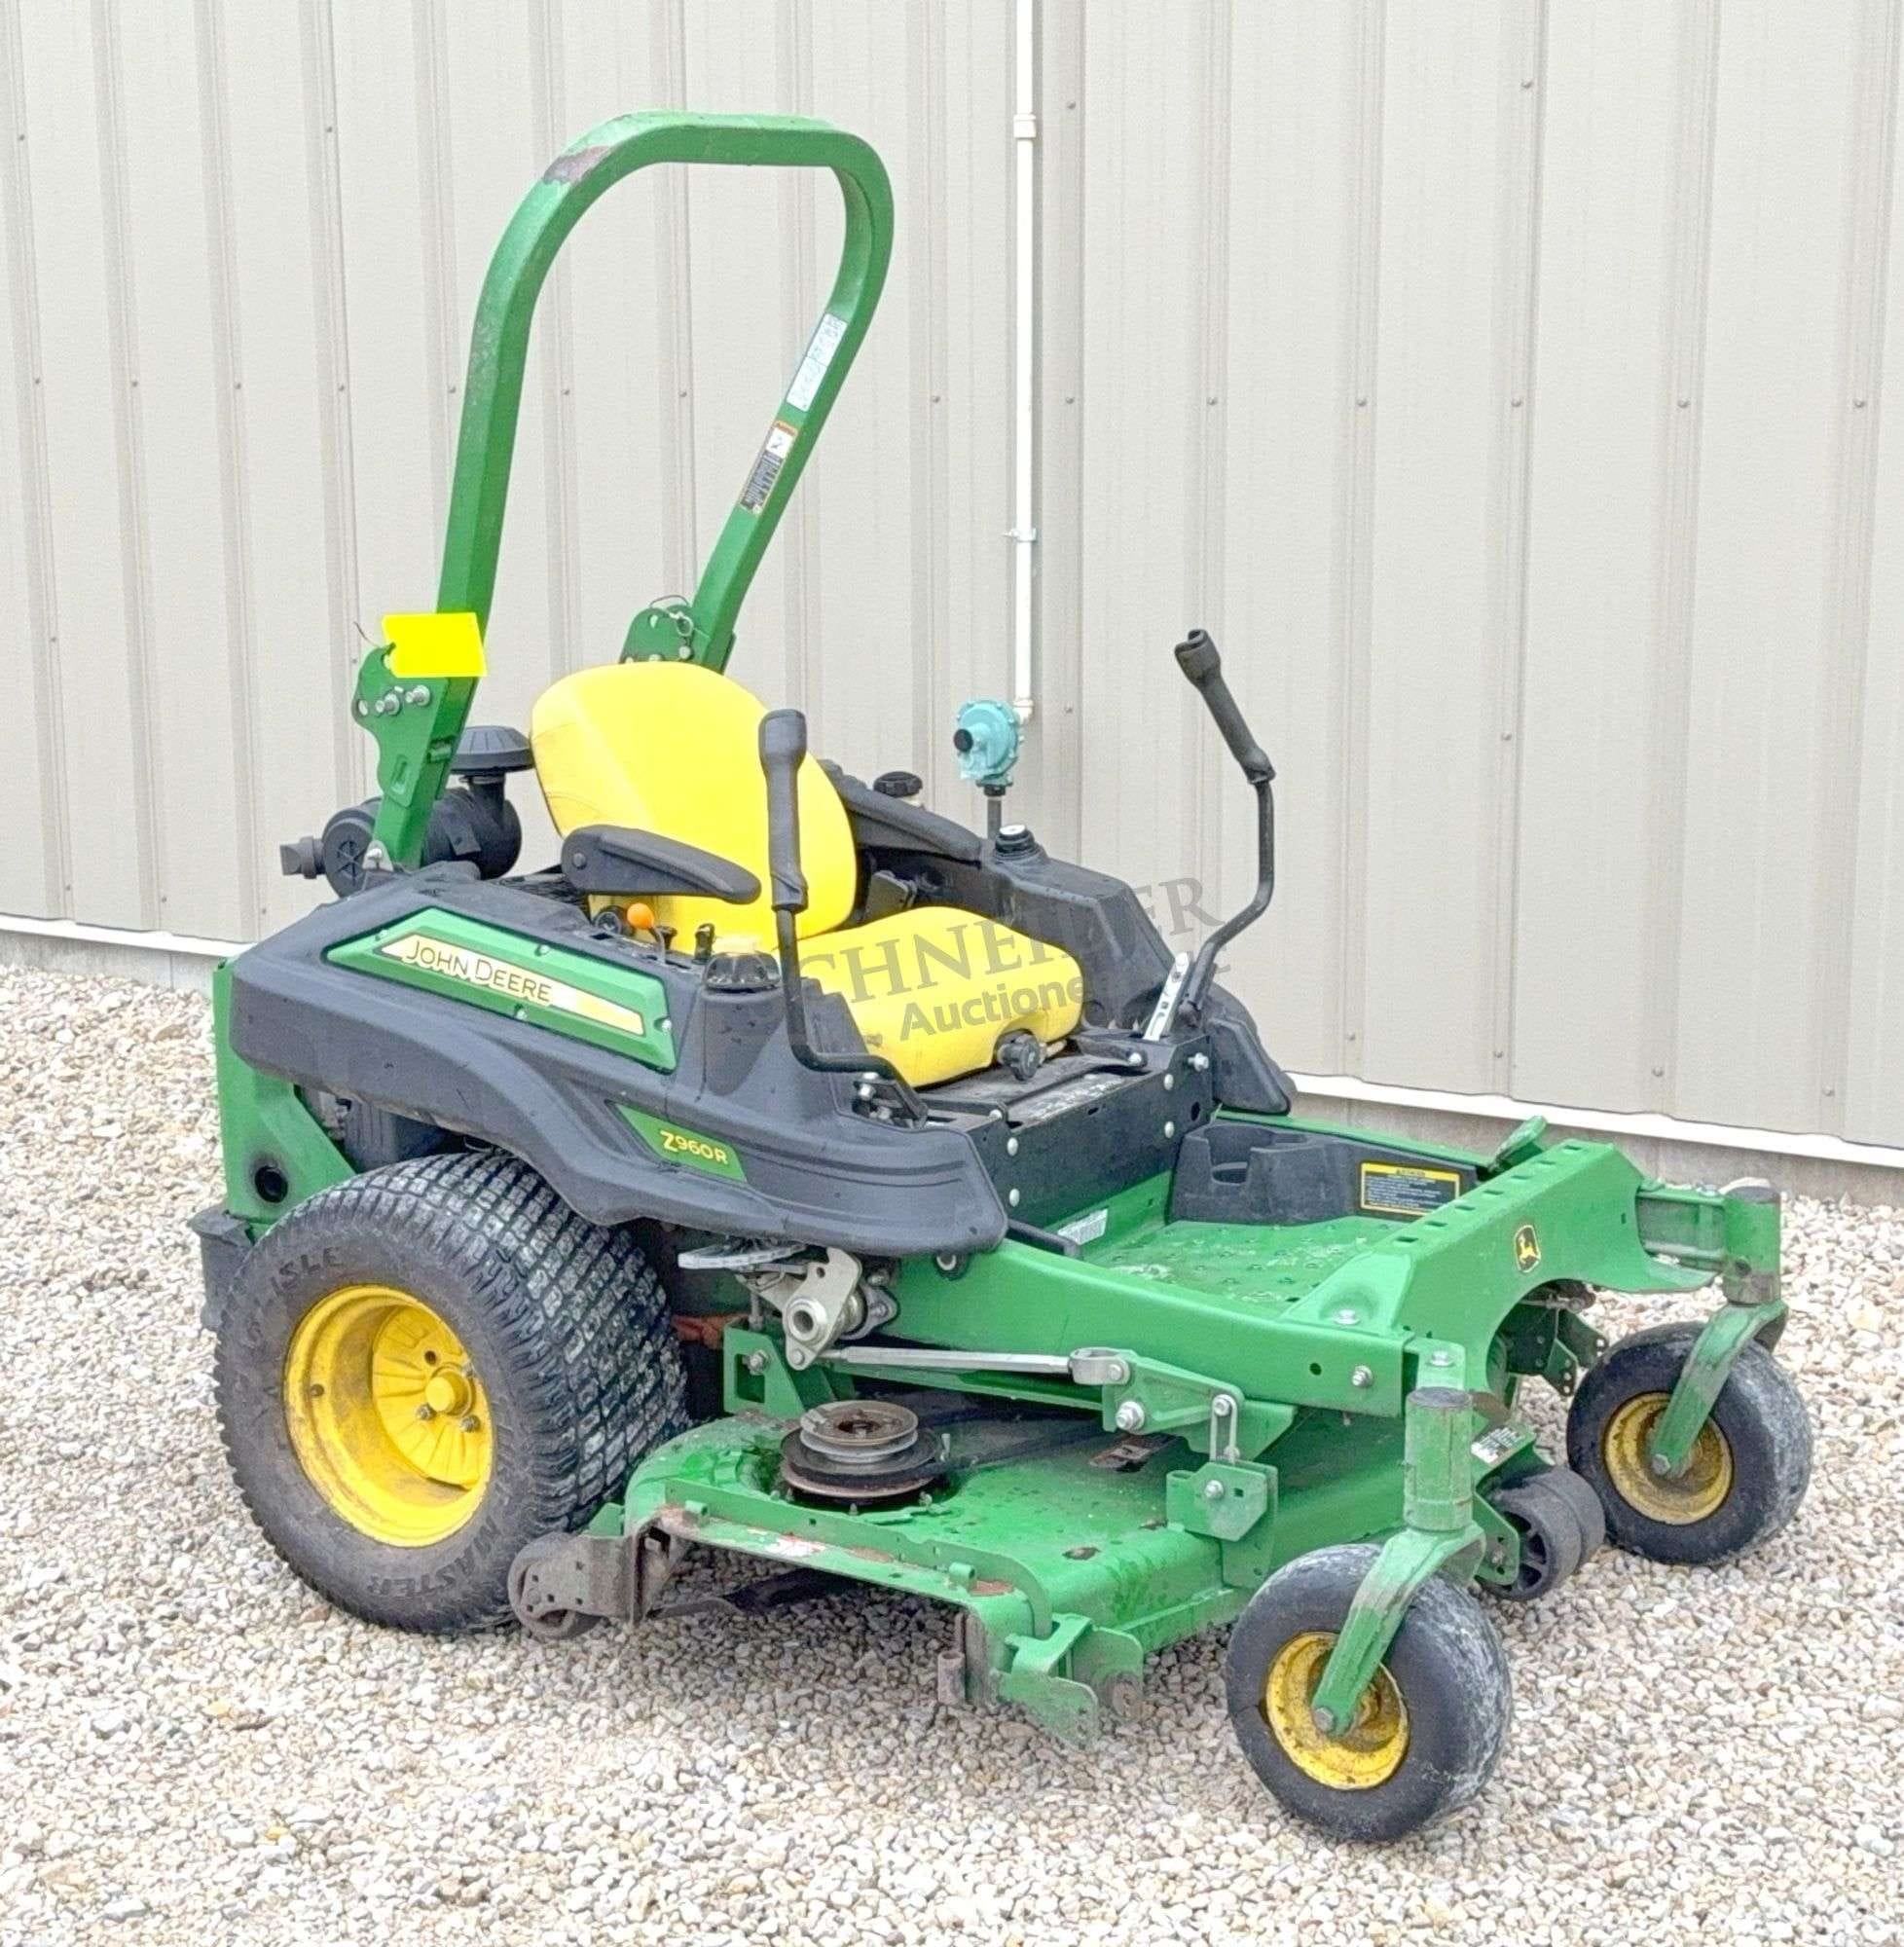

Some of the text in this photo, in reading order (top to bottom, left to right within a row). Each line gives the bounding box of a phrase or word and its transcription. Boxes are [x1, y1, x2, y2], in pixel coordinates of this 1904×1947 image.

[406, 939, 553, 1003] JOHN DEERE
[659, 1129, 730, 1165] Z960R
